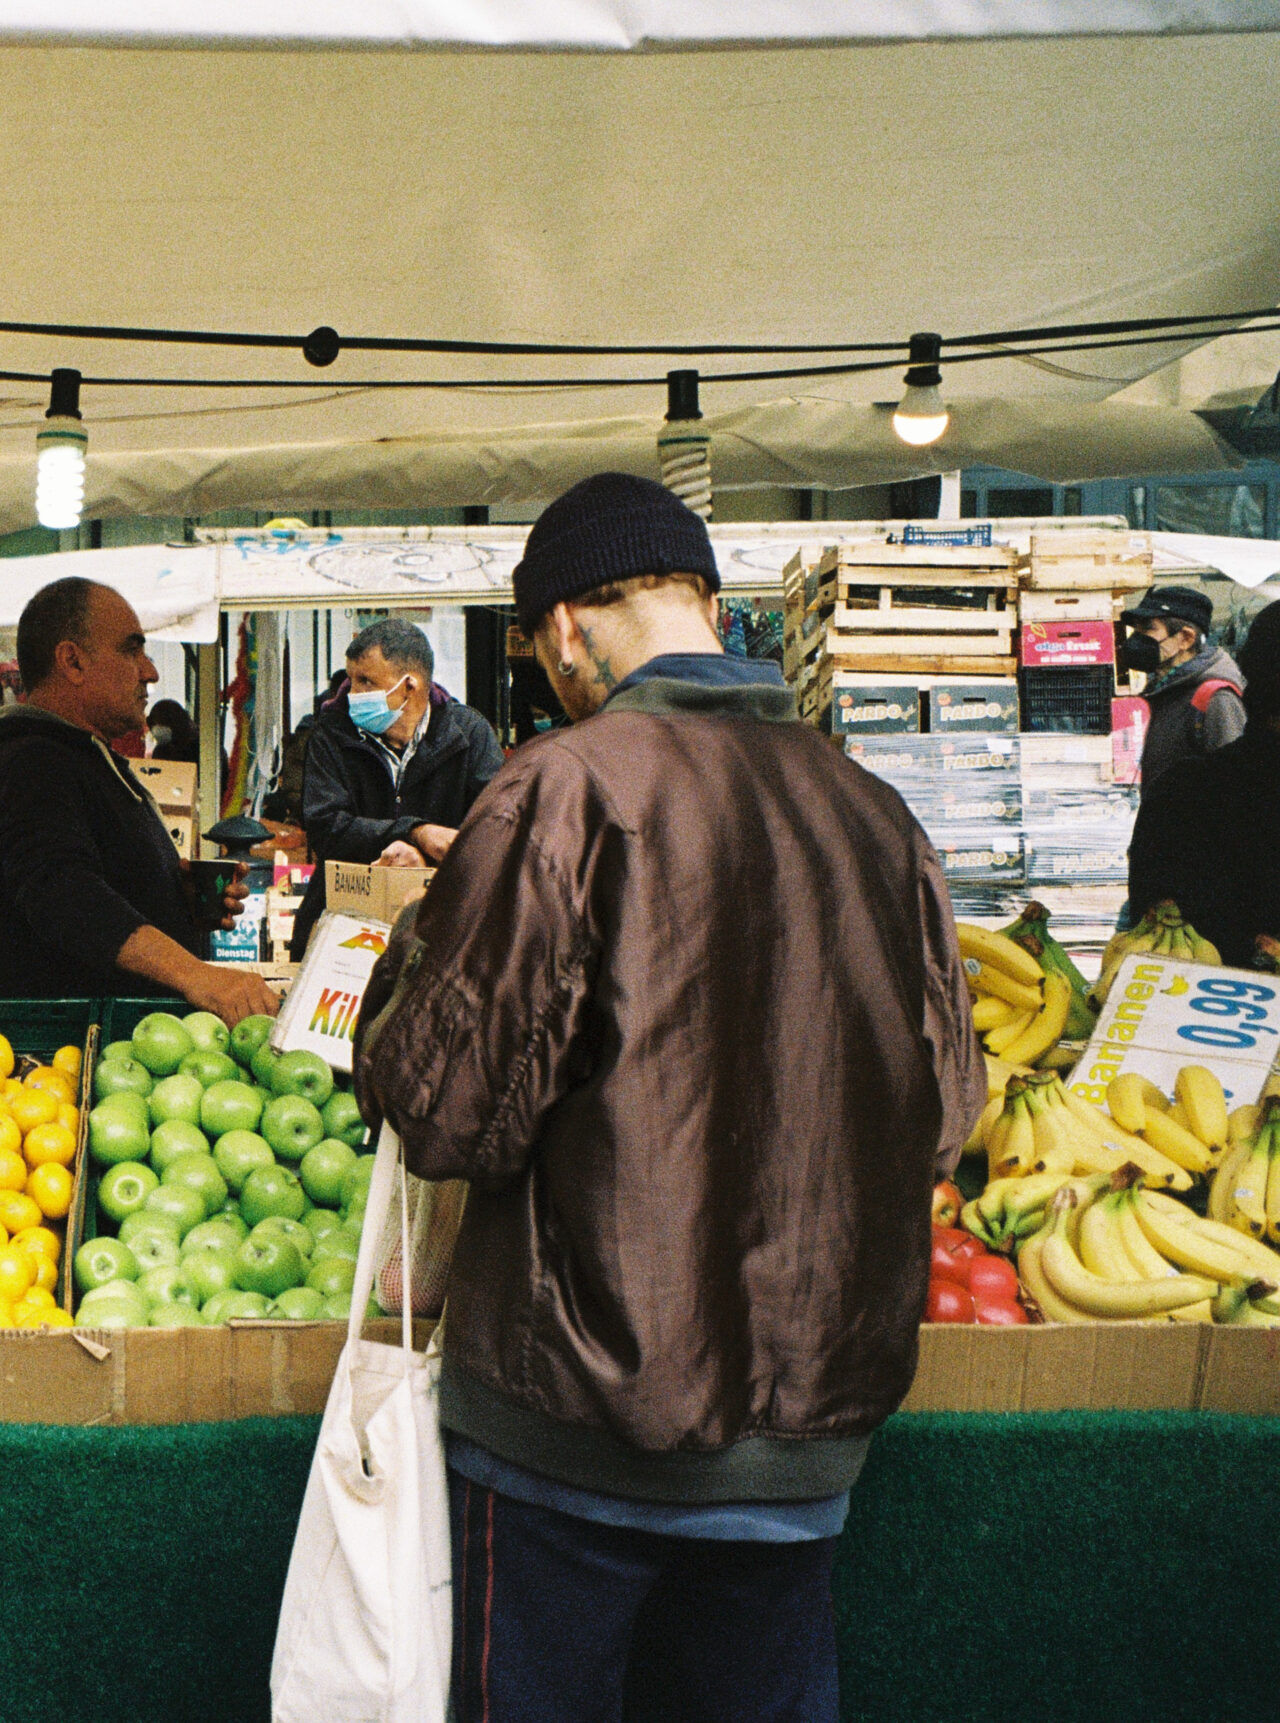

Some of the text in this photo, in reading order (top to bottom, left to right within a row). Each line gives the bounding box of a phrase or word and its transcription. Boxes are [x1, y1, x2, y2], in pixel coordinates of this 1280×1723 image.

[841, 703, 903, 723] PARDO
[940, 702, 1003, 722] PARDO
[943, 752, 1005, 770] PARDO
[945, 850, 1008, 868] PARDO
[334, 872, 372, 896] BANANAS
[216, 948, 256, 959] Dienstag
[1176, 978, 1279, 1050] 0,99
[1070, 963, 1165, 1106] Bananen
